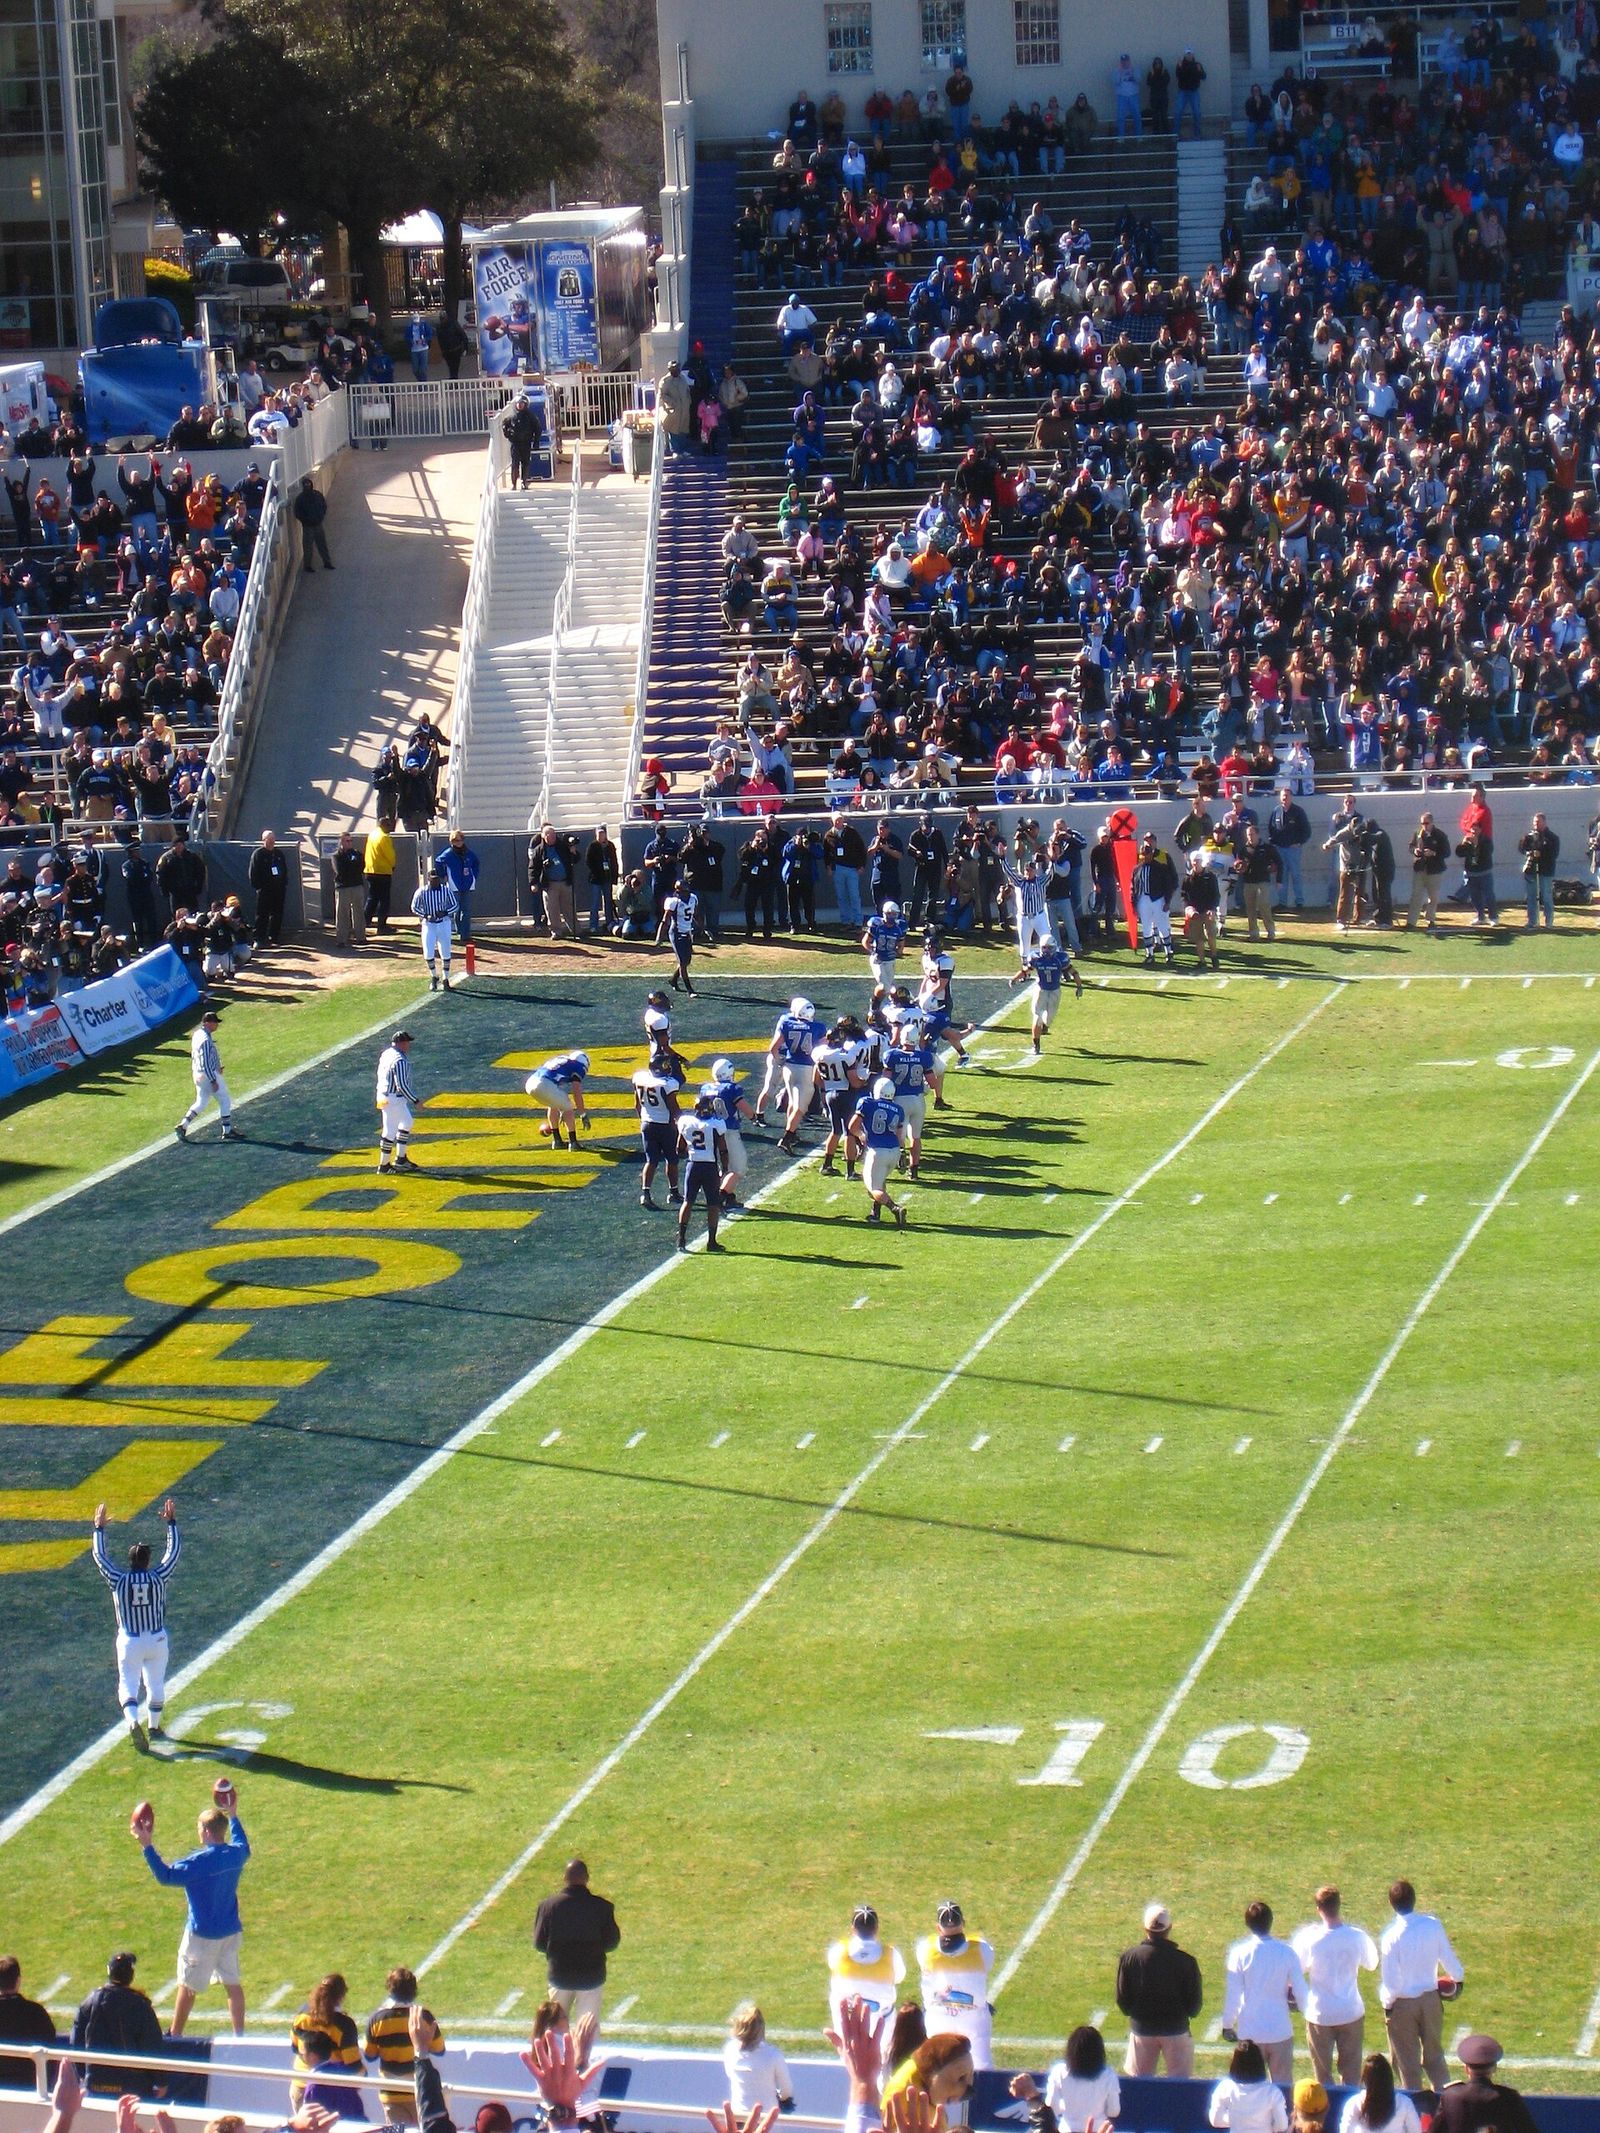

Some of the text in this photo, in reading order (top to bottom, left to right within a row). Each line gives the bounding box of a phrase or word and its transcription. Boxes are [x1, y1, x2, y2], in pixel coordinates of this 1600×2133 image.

[1336, 26, 1356, 38] B11
[484, 256, 513, 282] AIR
[481, 266, 529, 301] FORCE
[684, 907, 691, 921] 5
[83, 999, 128, 1028] Charter
[2, 1033, 27, 1056] PROUD
[22, 1030, 37, 1048] TO
[32, 1020, 63, 1044] SUPPORT
[788, 1031, 813, 1055] 74
[26, 1048, 52, 1072] ARMED
[818, 1062, 841, 1081] 91
[692, 1130, 706, 1150] 2
[131, 1583, 150, 1606] H
